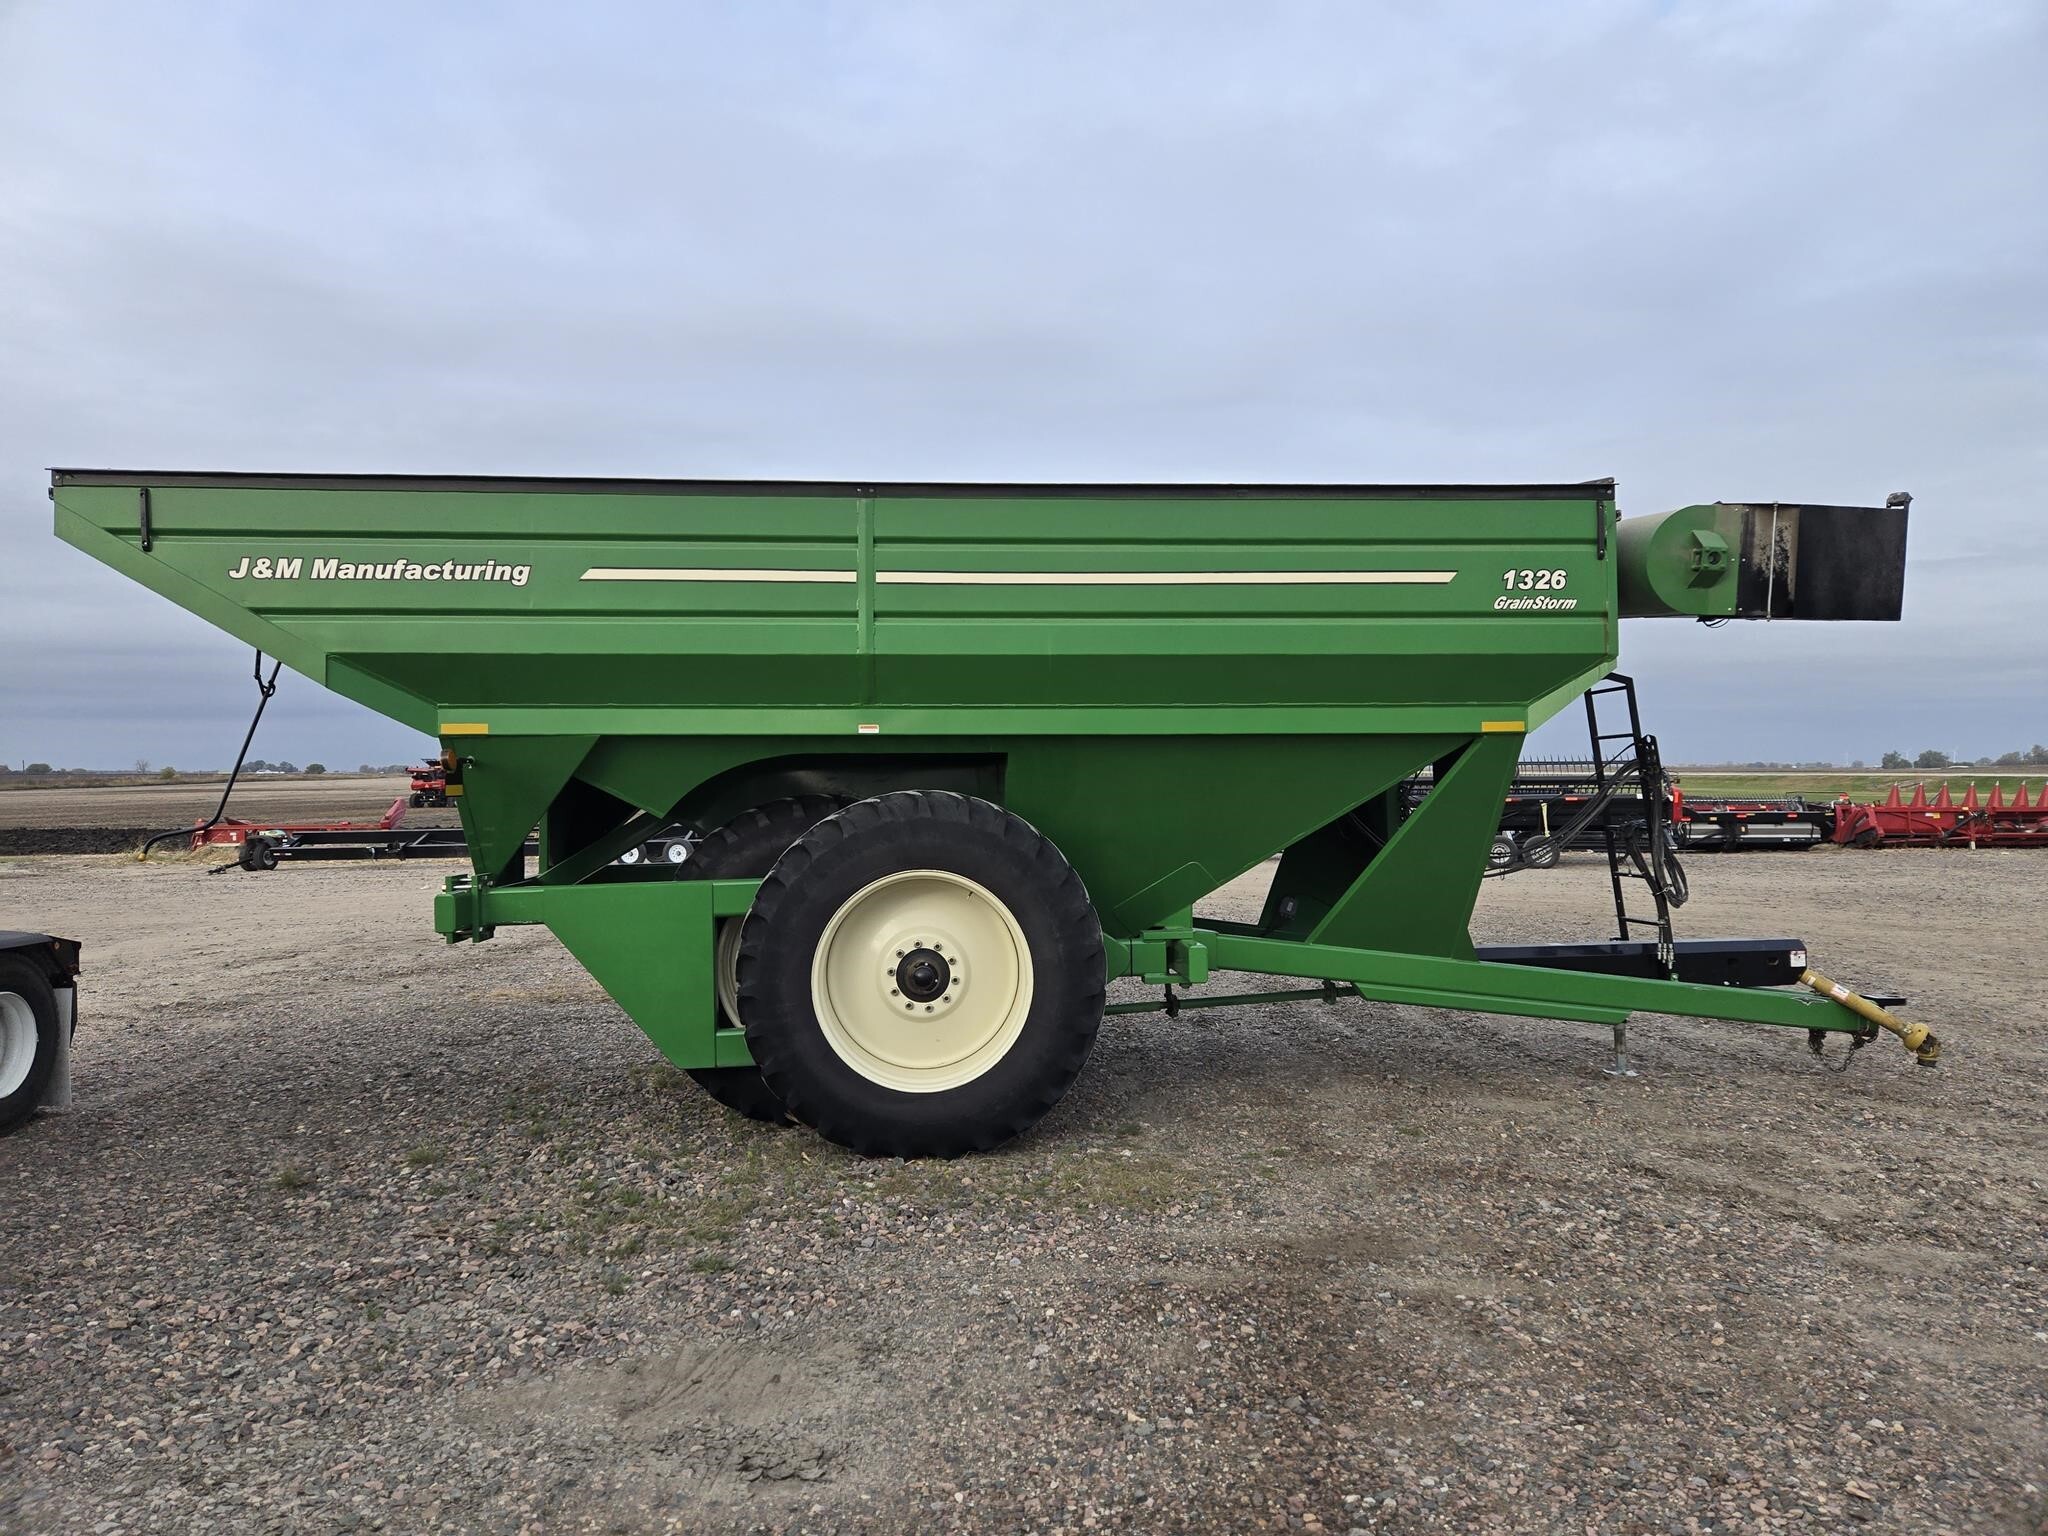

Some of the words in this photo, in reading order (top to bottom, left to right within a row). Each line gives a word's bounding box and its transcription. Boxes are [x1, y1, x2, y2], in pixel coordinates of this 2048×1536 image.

[229, 557, 303, 580] J&M
[310, 557, 531, 586] Manufacturing
[1502, 568, 1568, 590] 1326
[1493, 595, 1577, 610] GrainStorm
